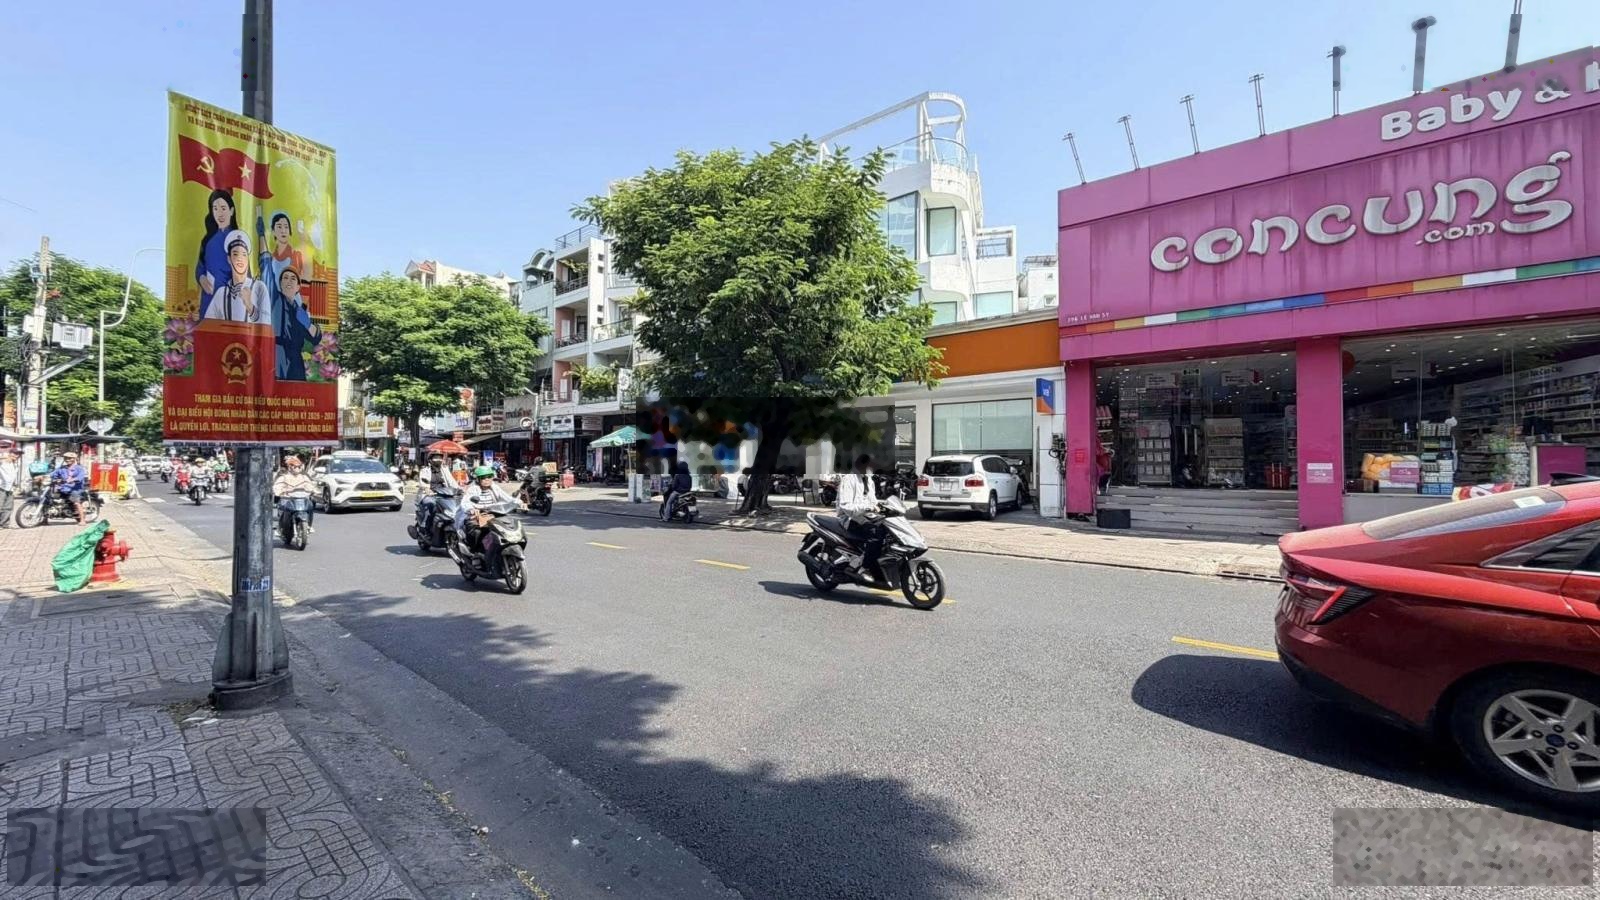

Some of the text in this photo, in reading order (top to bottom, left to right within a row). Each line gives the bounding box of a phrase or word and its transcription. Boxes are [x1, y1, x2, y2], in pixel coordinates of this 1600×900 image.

[1381, 88, 1522, 141] Baby
[1150, 151, 1573, 272] concung
[194, 393, 211, 403] THAM
